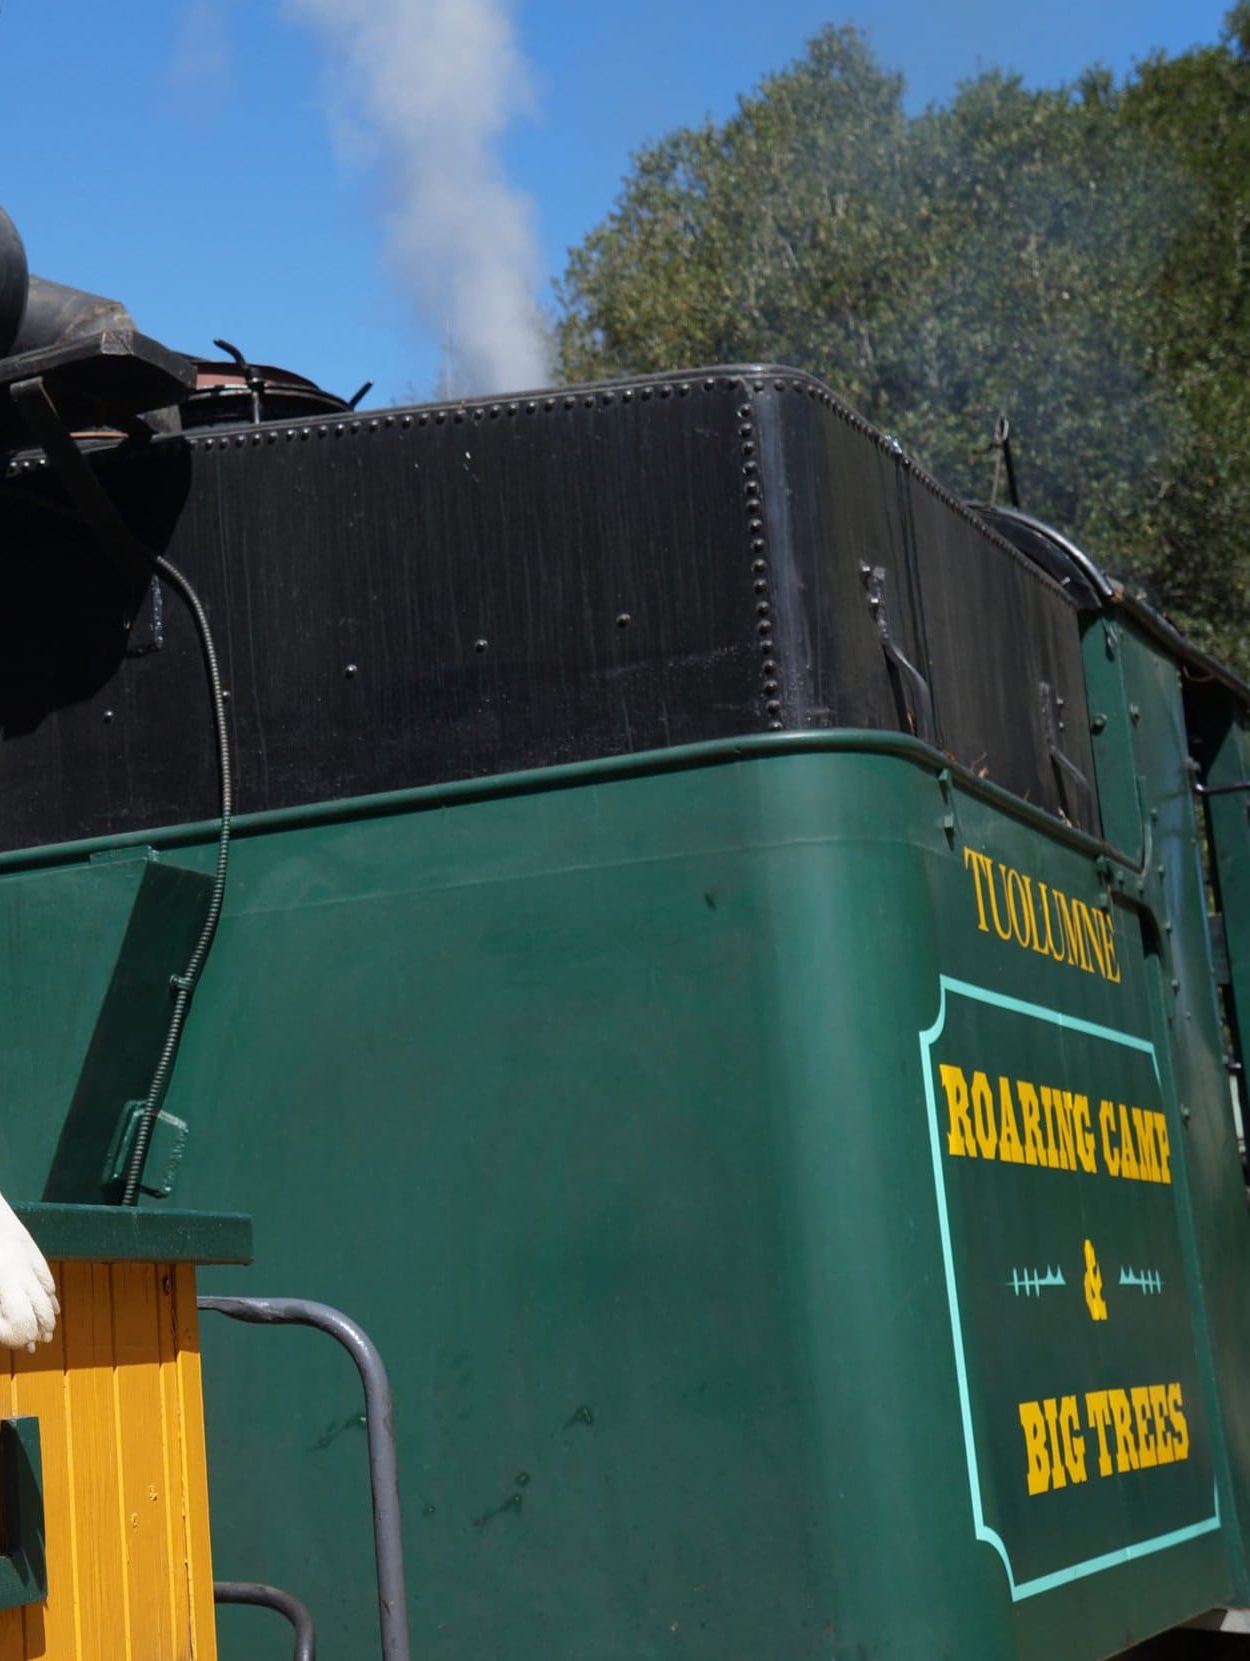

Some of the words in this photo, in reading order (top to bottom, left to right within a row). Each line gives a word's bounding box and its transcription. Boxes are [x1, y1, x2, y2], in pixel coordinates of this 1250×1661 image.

[964, 846, 1121, 984] TUOLUMNE
[939, 1063, 1098, 1174] ROARING
[1099, 1100, 1172, 1184] CAMP
[1083, 1239, 1108, 1320] &
[1018, 1395, 1087, 1496] BIG
[1085, 1382, 1190, 1477] TREES
